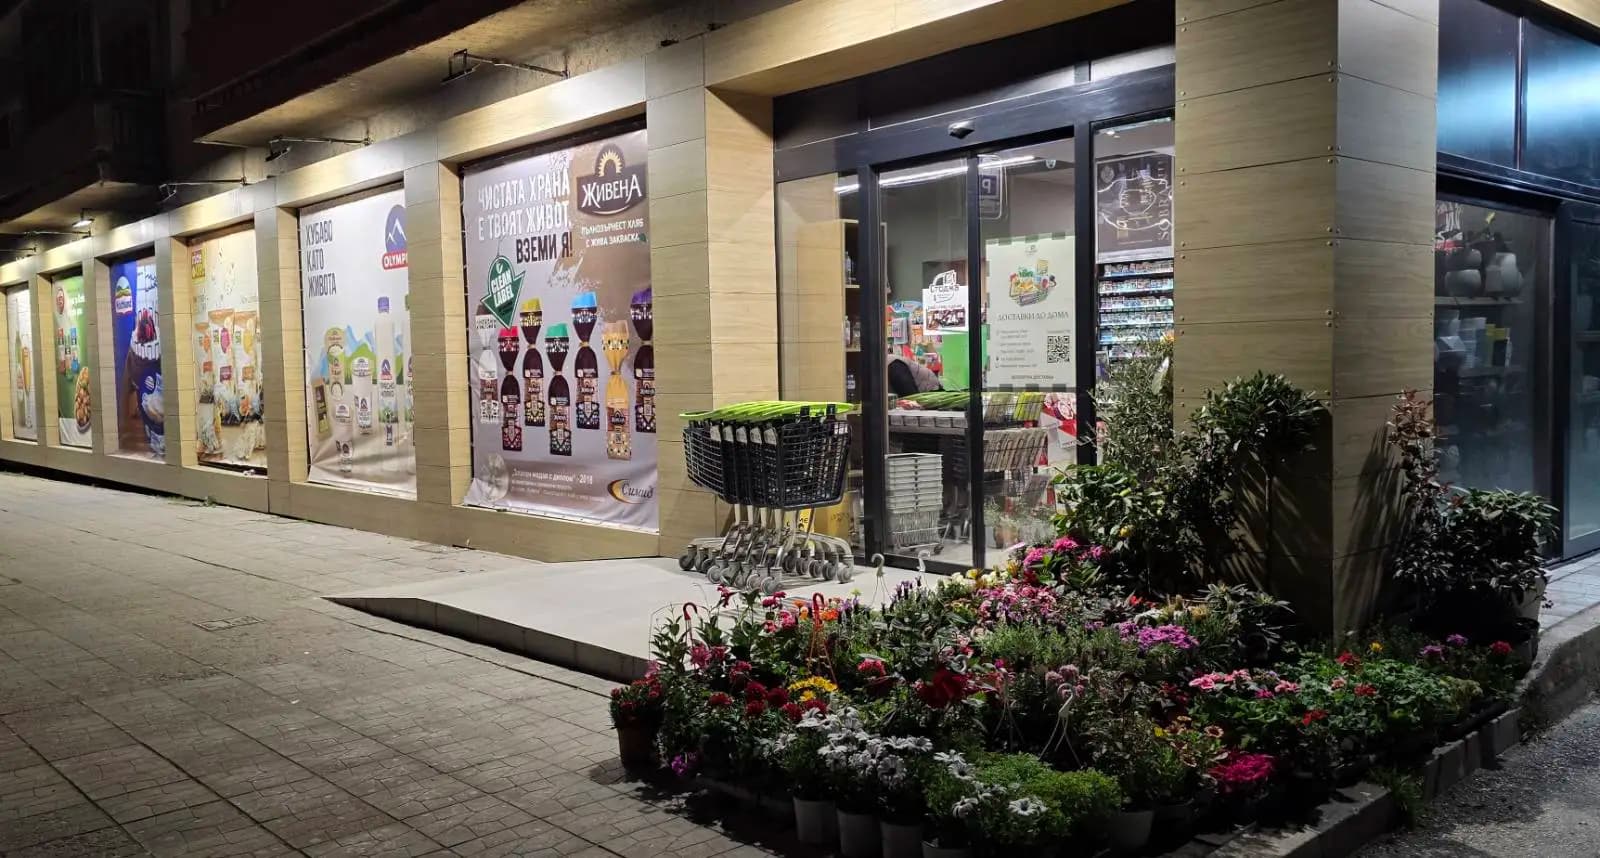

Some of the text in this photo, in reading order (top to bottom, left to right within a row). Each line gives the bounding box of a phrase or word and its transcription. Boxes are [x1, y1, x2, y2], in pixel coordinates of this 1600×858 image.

[478, 167, 571, 211] ЧИСТАТА ХРАНА
[581, 174, 643, 209] ЖИВЕНА
[305, 219, 333, 246] ХУБАВО
[478, 215, 485, 241] Е
[487, 208, 523, 240] ТВОЯТ
[306, 248, 325, 272] КАТО
[516, 231, 573, 264] ВЗЕМИ Я!
[308, 272, 337, 299] ЖИВОТА
[490, 269, 513, 294] CLEAN
[493, 283, 515, 308] LABEL
